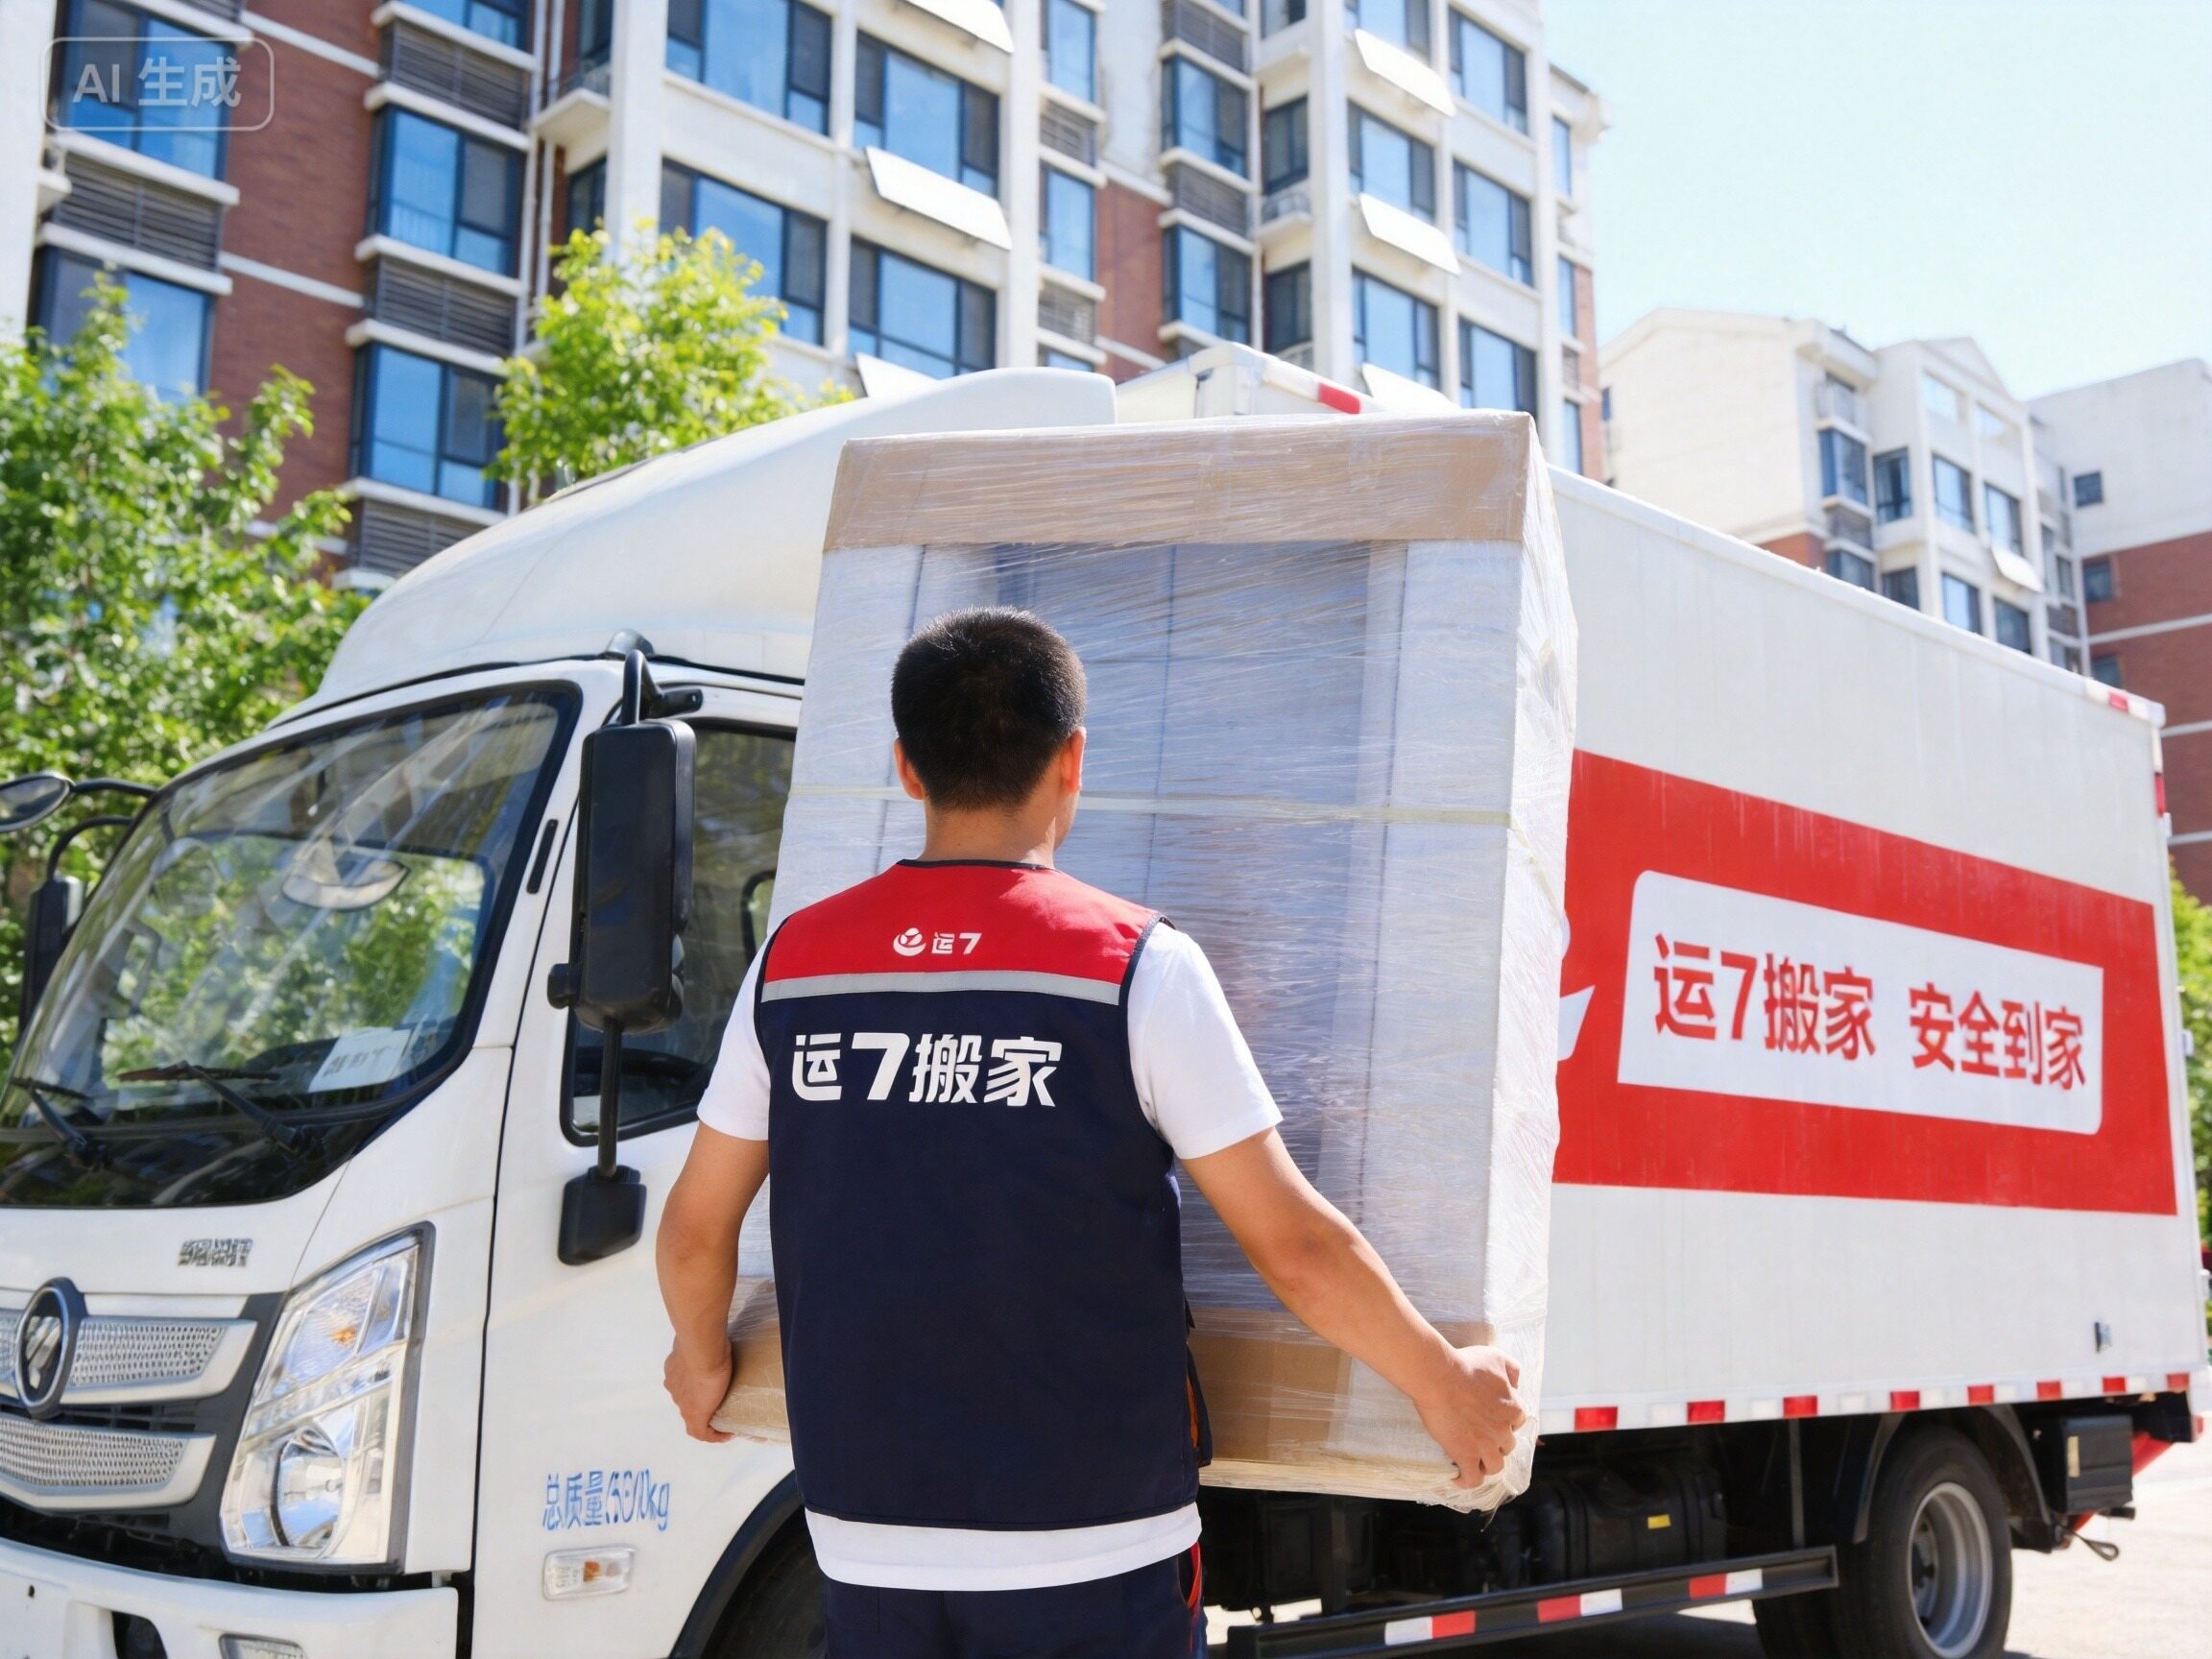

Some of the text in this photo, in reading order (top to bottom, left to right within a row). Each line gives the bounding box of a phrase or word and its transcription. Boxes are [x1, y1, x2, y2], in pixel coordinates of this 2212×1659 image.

[931, 931, 982, 955] 运7
[1653, 933, 2086, 1091] 运7搬家 安全到家
[791, 1032, 1063, 1108] 运7搬家
